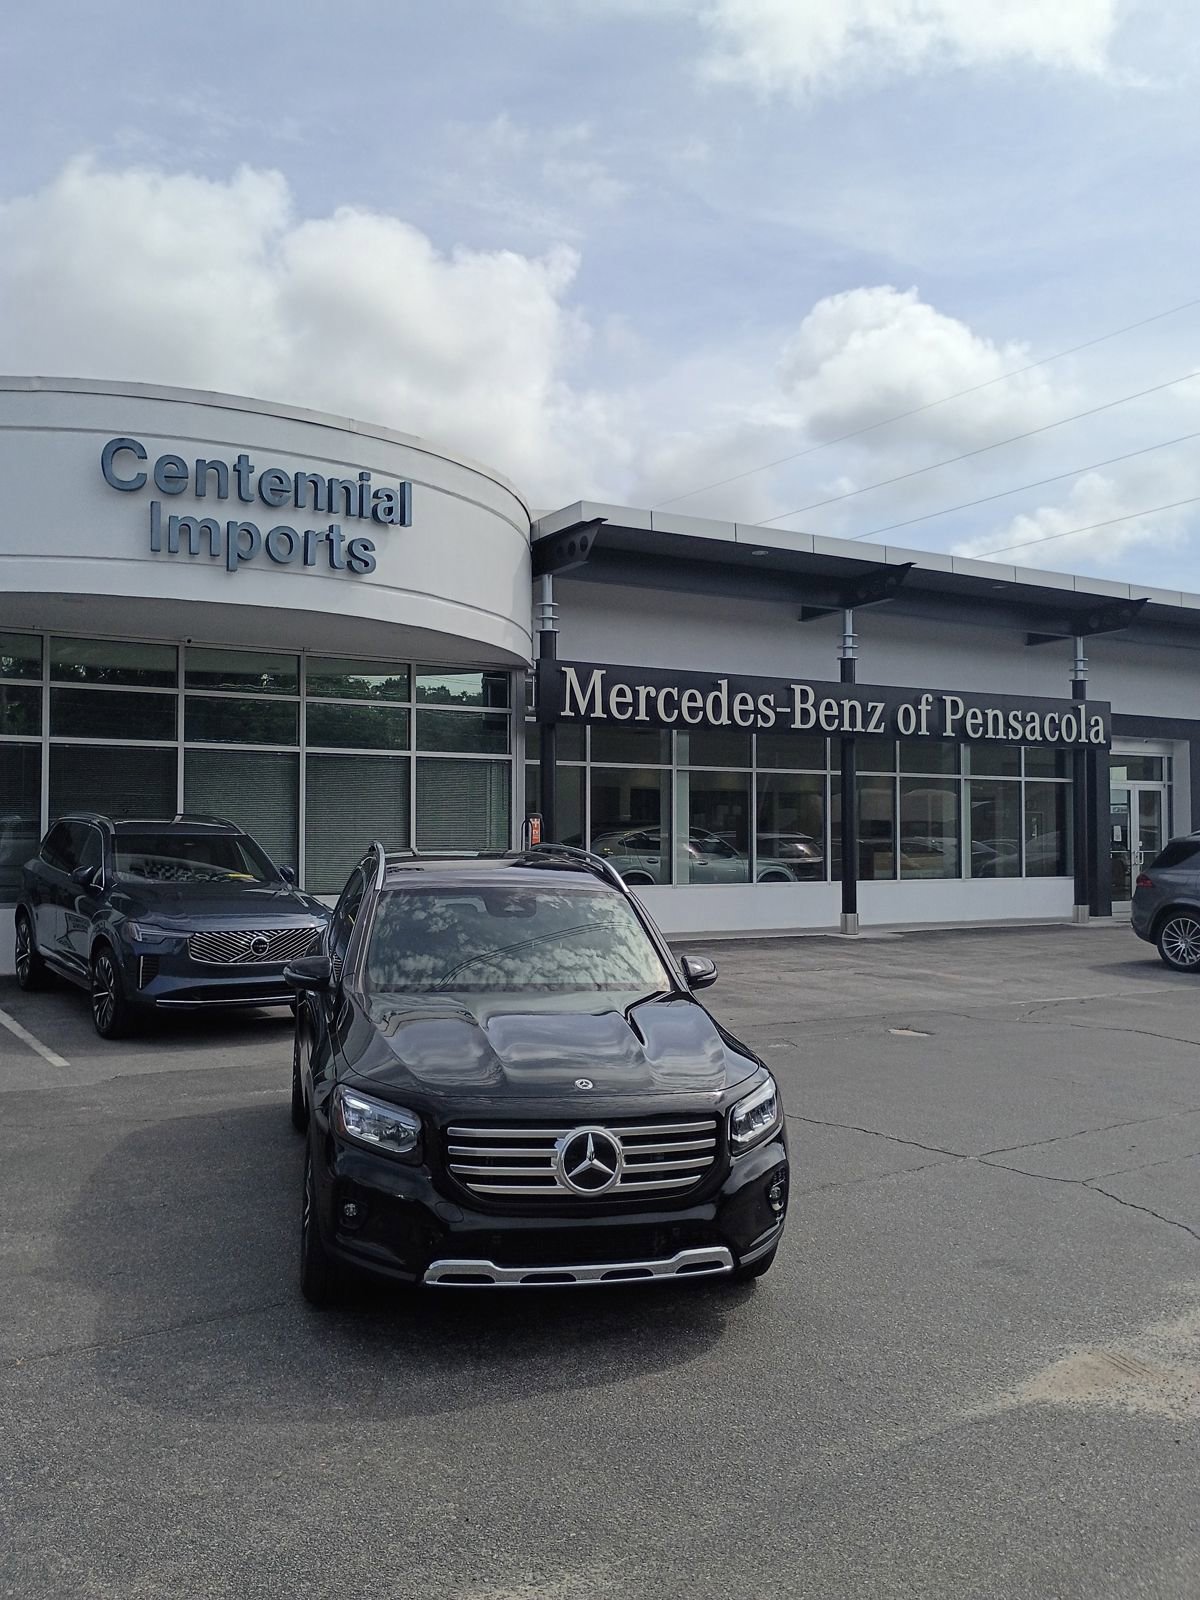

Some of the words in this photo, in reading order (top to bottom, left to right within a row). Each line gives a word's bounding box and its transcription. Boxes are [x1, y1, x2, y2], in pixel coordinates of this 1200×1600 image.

[102, 438, 412, 527] Centennial
[150, 501, 376, 574] Imports
[560, 667, 885, 734] Mercedes-Benz
[897, 695, 932, 736] of
[942, 695, 1106, 744] Pensacola
